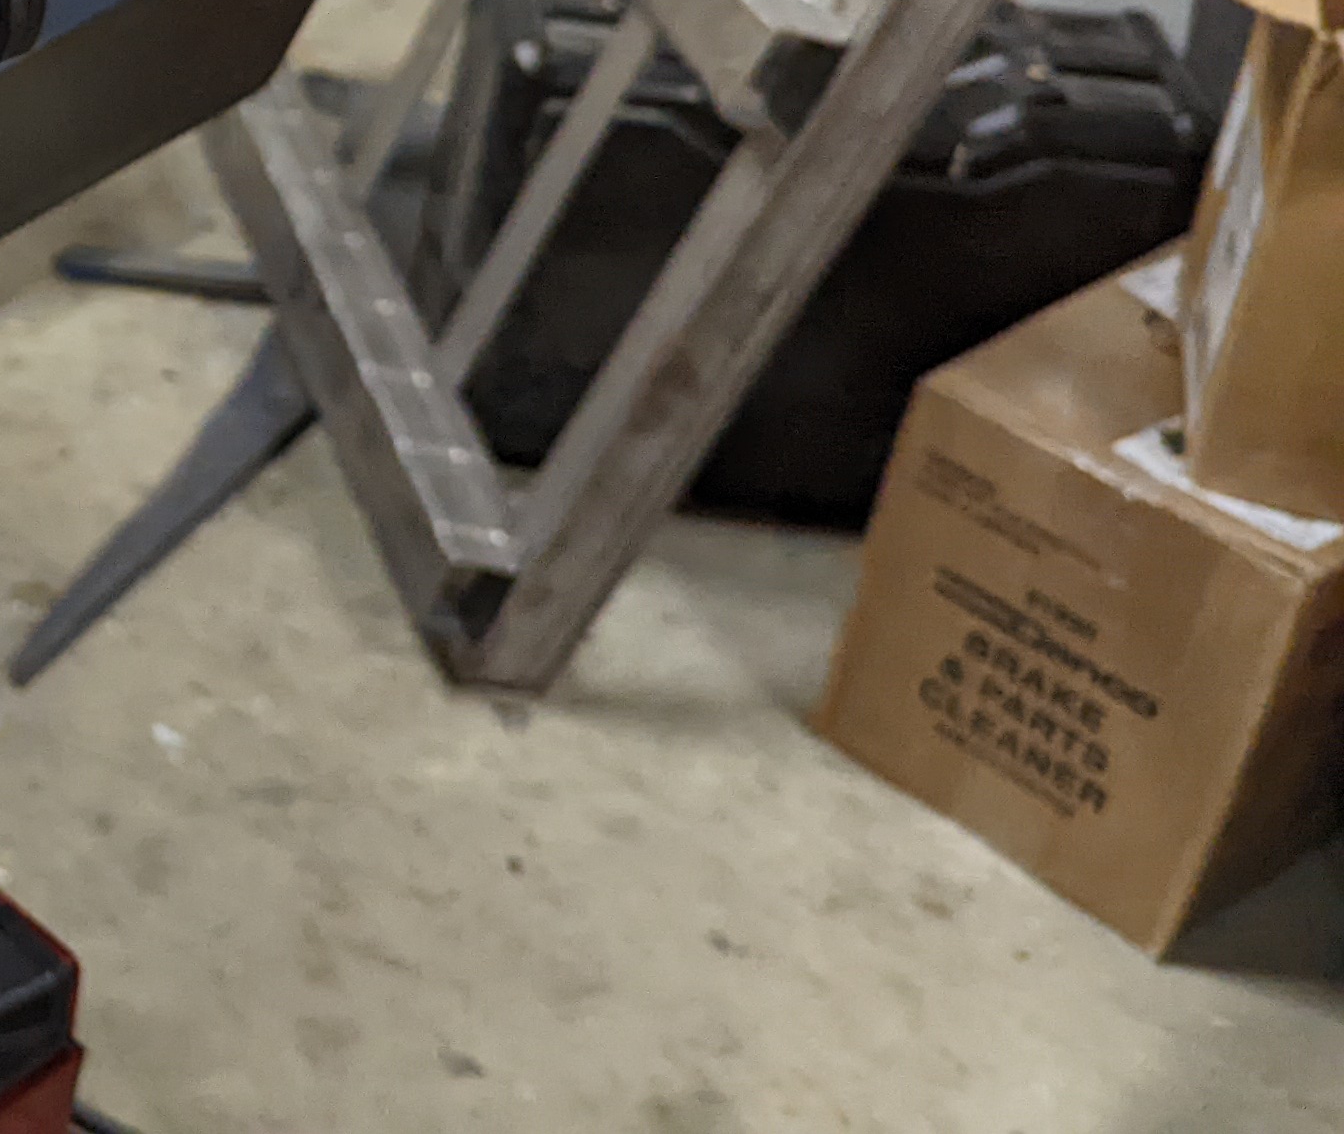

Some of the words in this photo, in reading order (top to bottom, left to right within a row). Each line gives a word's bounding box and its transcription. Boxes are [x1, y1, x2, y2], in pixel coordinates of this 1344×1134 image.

[965, 630, 1104, 733] BRAKE
[980, 675, 1109, 772] PARTS
[919, 677, 1108, 814] CLEANER
